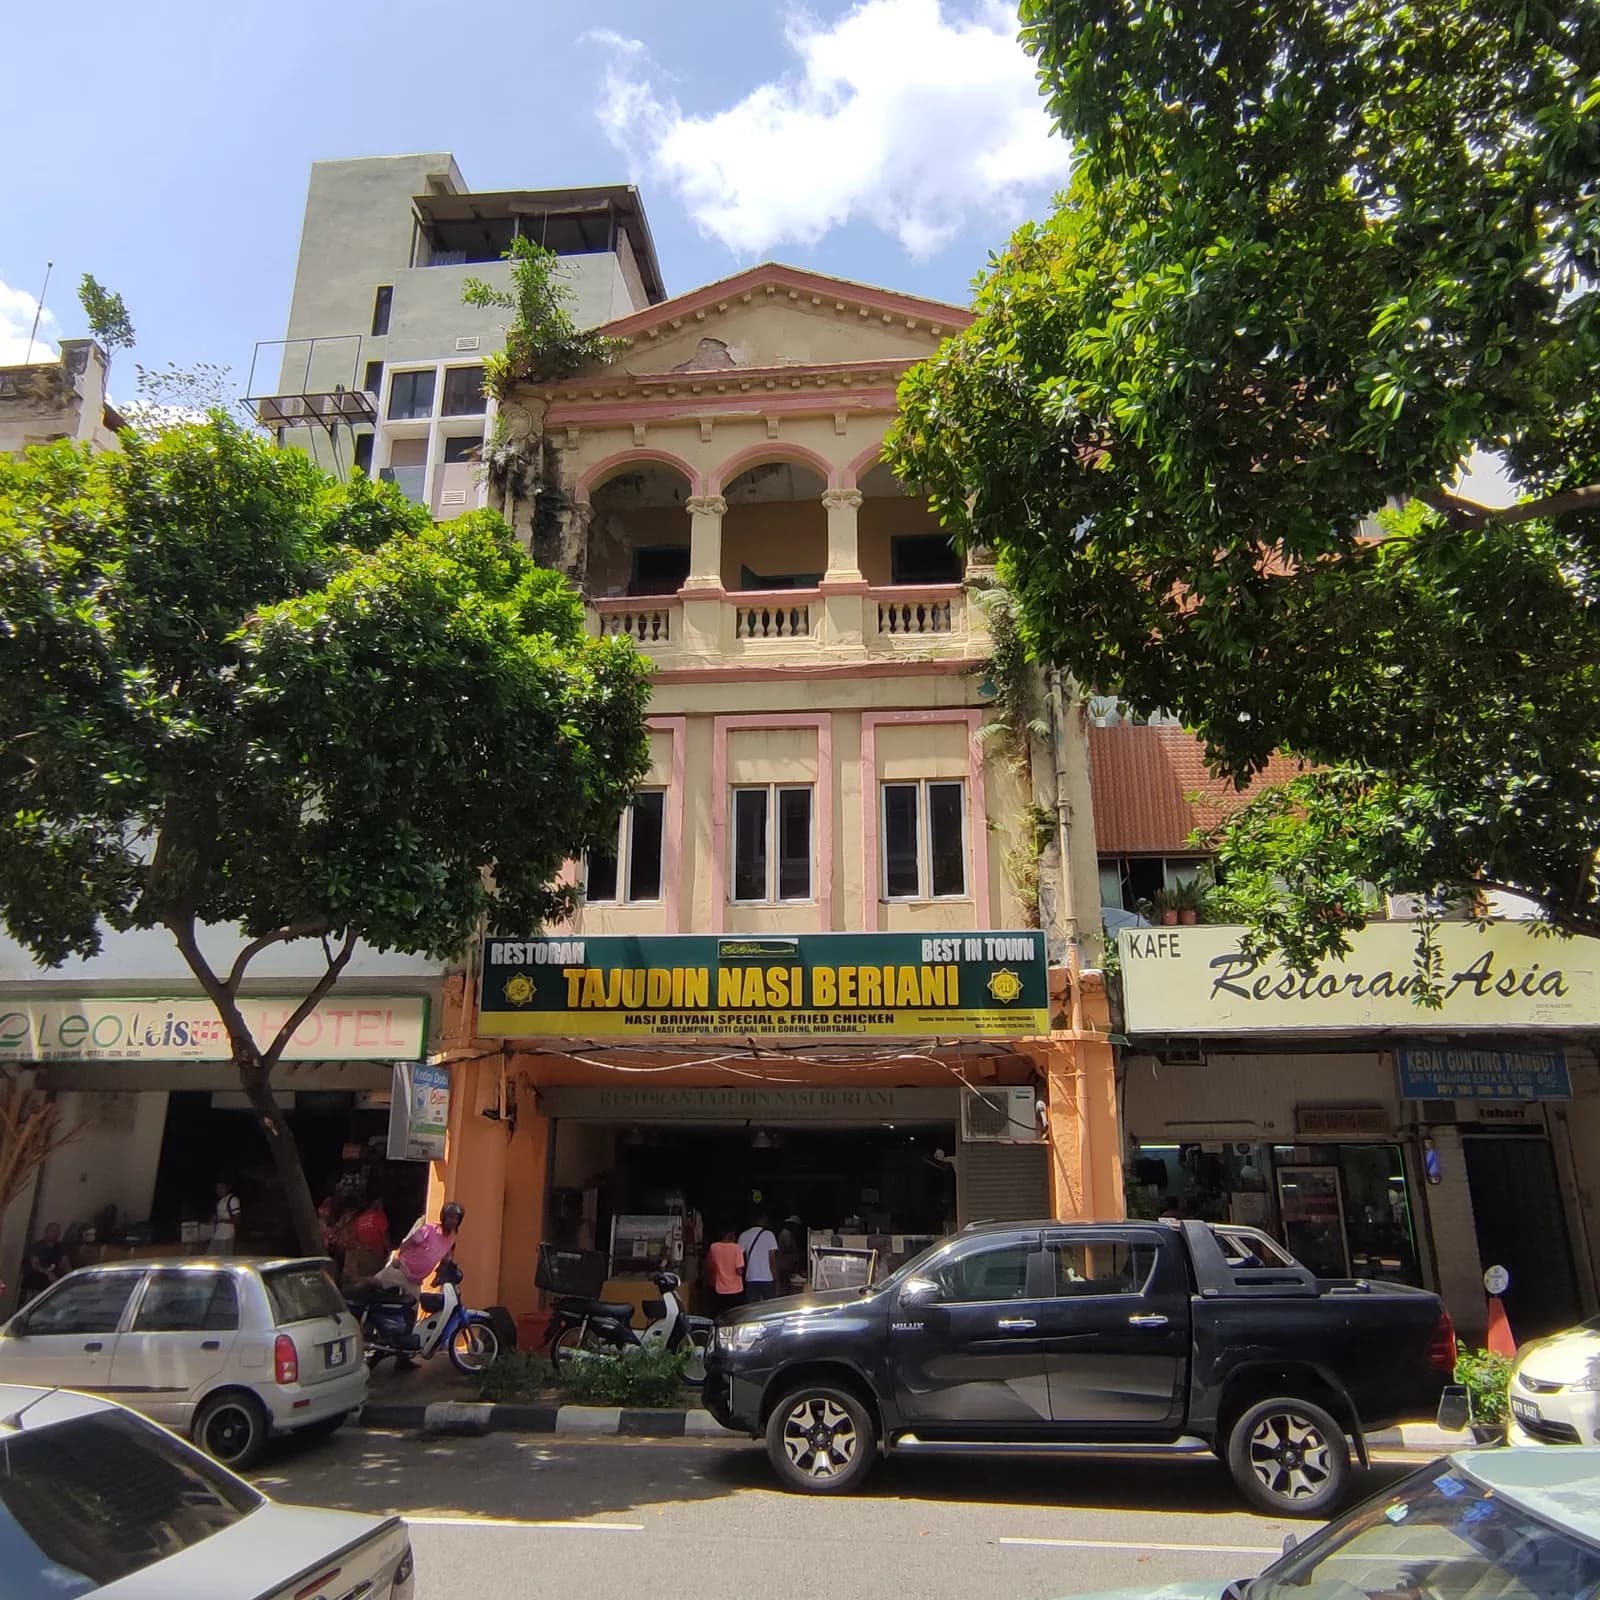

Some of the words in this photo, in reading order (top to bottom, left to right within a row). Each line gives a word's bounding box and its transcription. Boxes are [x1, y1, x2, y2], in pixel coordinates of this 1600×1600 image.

[491, 942, 585, 965] RESTORAN
[921, 938, 962, 963] BEST
[965, 938, 982, 962] IN
[984, 937, 1035, 962] TOWN
[1130, 934, 1182, 960] KAFE
[563, 967, 709, 1009] TAJUDIN
[717, 966, 803, 1008] NASI
[812, 965, 960, 1008] BERIANI
[1208, 953, 1421, 1000] Restoran
[1444, 950, 1569, 999] Asia
[257, 1009, 406, 1047] HOTEL
[624, 1014, 657, 1025] NASI
[660, 1014, 715, 1025] BRIYANI
[717, 1014, 774, 1025] SPECIAL
[777, 1015, 787, 1025] &
[790, 1014, 830, 1025] FRIED
[832, 1013, 895, 1024] CHICKEN
[1407, 1051, 1444, 1072] KEDAI
[1447, 1051, 1501, 1072] GUNTING
[1505, 1053, 1557, 1073] RAMBUT
